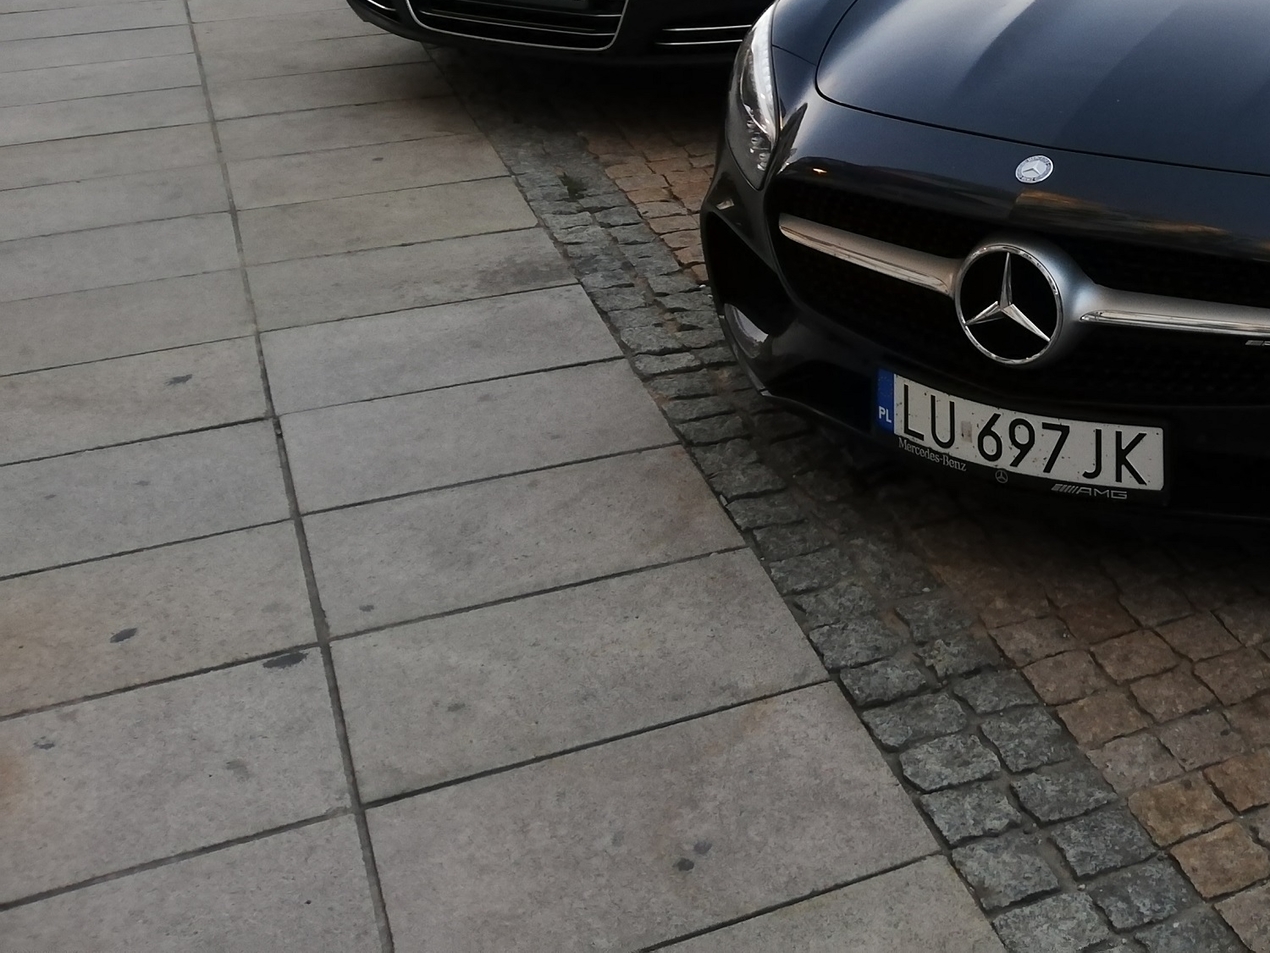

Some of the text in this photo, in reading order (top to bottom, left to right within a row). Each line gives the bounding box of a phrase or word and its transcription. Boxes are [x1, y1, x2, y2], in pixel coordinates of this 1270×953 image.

[879, 405, 892, 423] PL
[903, 384, 1148, 486] LU 697 JK
[898, 437, 967, 472] Mercedes-Benz
[1075, 486, 1128, 500] AMG
